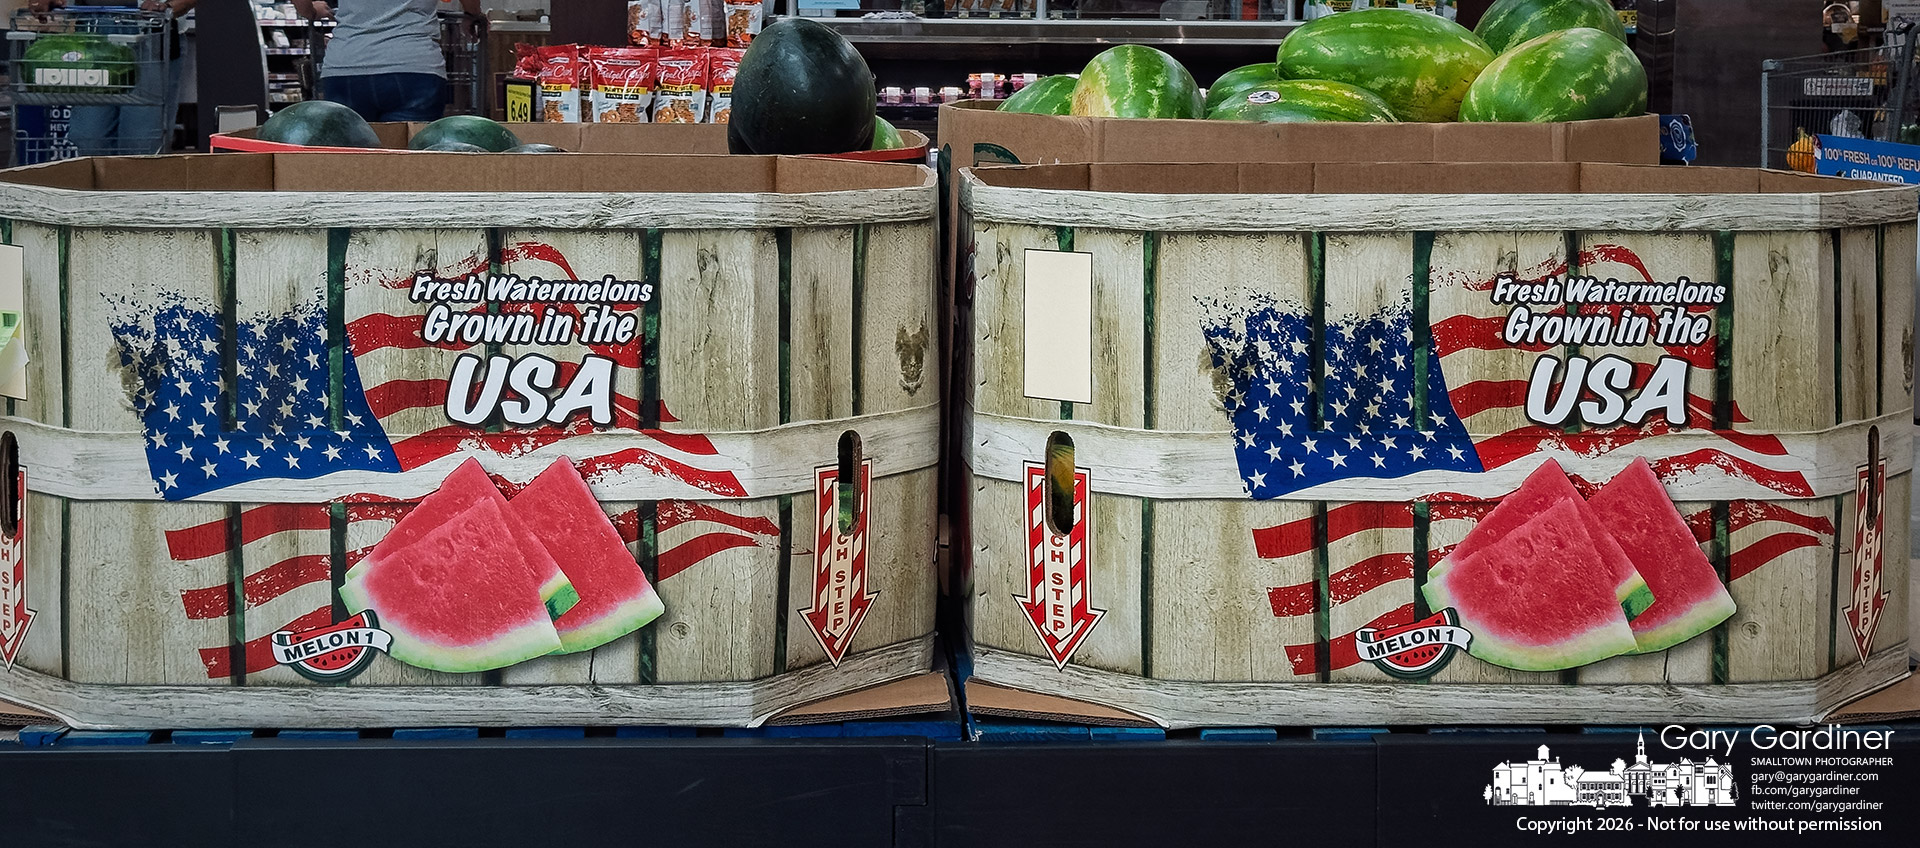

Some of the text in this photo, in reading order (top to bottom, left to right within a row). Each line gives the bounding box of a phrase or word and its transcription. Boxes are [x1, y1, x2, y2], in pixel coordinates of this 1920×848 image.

[511, 100, 528, 122] 6.49
[1843, 150, 1871, 165] FRESH
[411, 275, 653, 302] Fresh Watermelons
[1492, 278, 1727, 303] Fresh Watermelons
[425, 305, 636, 344] Grown in the
[1505, 306, 1709, 345] Grown in the
[446, 355, 614, 425] USA
[1527, 356, 1689, 425] USA
[1, 571, 11, 631] STEP
[833, 570, 846, 631] STEP
[1051, 572, 1065, 632] STEP
[1861, 570, 1871, 630] STEP
[283, 631, 374, 661] MELON 1
[1366, 628, 1455, 659] MELON 1
